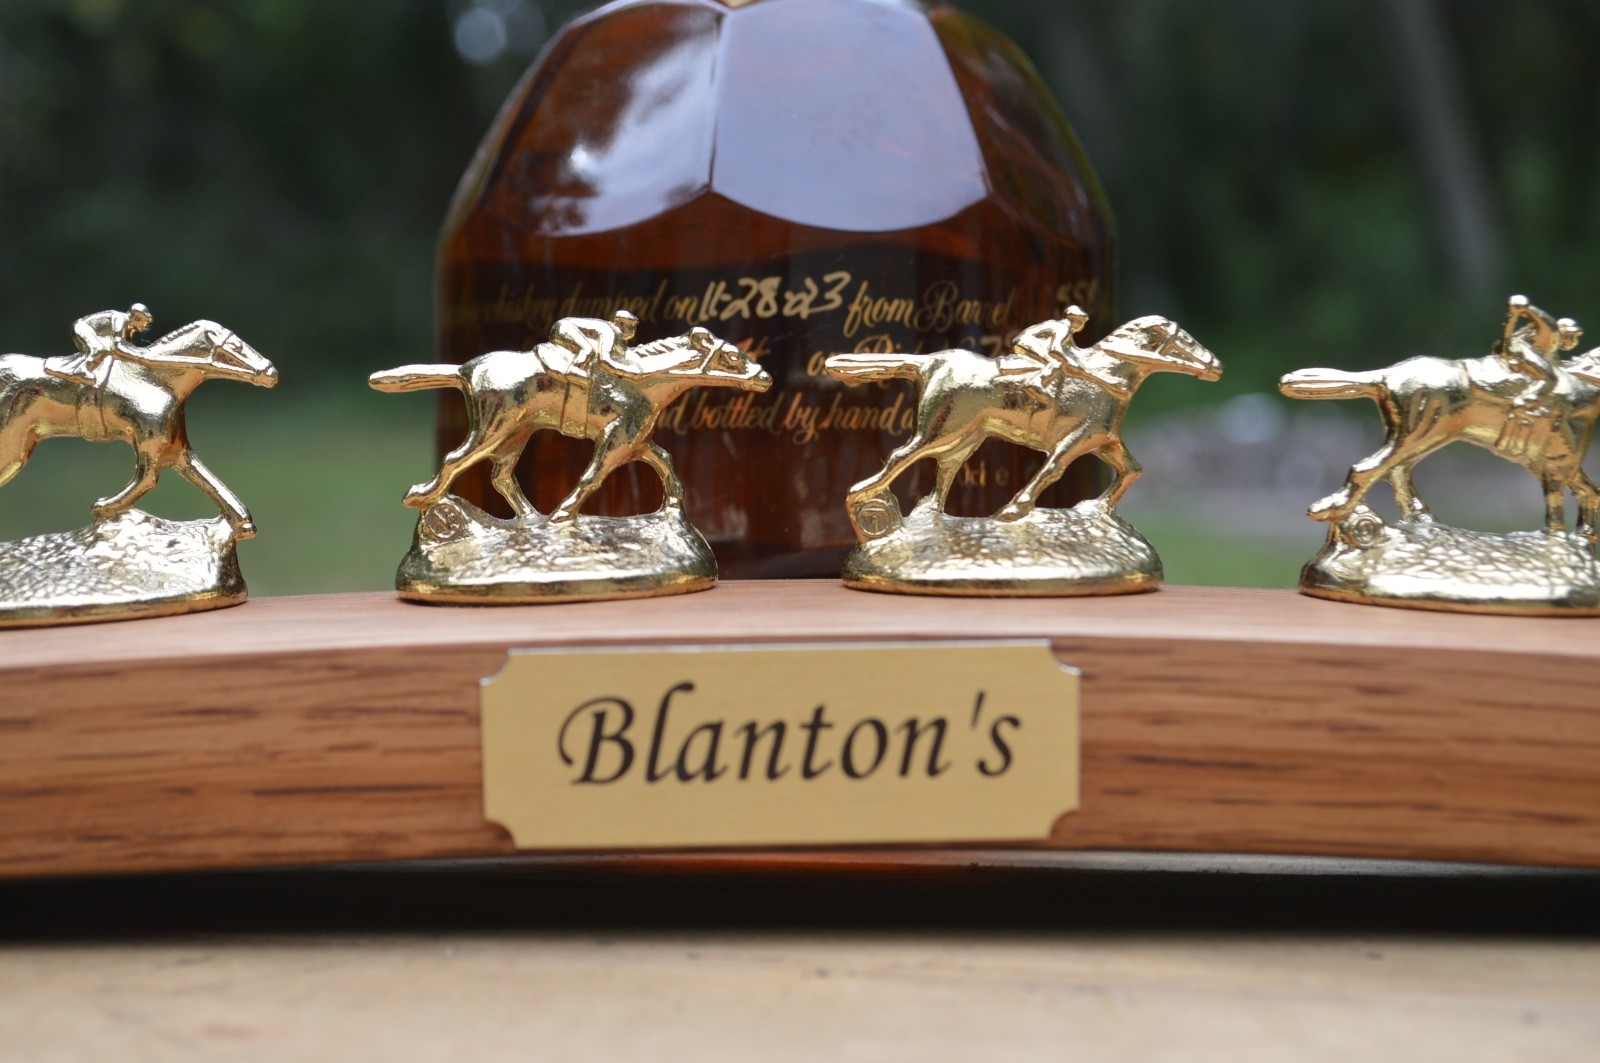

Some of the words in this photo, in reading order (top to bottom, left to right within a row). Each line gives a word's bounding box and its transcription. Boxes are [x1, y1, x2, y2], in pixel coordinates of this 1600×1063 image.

[663, 294, 702, 326] on
[843, 280, 914, 338] from
[688, 391, 786, 436] bottled
[783, 390, 821, 445] by
[818, 391, 903, 436] hand
[557, 681, 1022, 787] Blanton's
